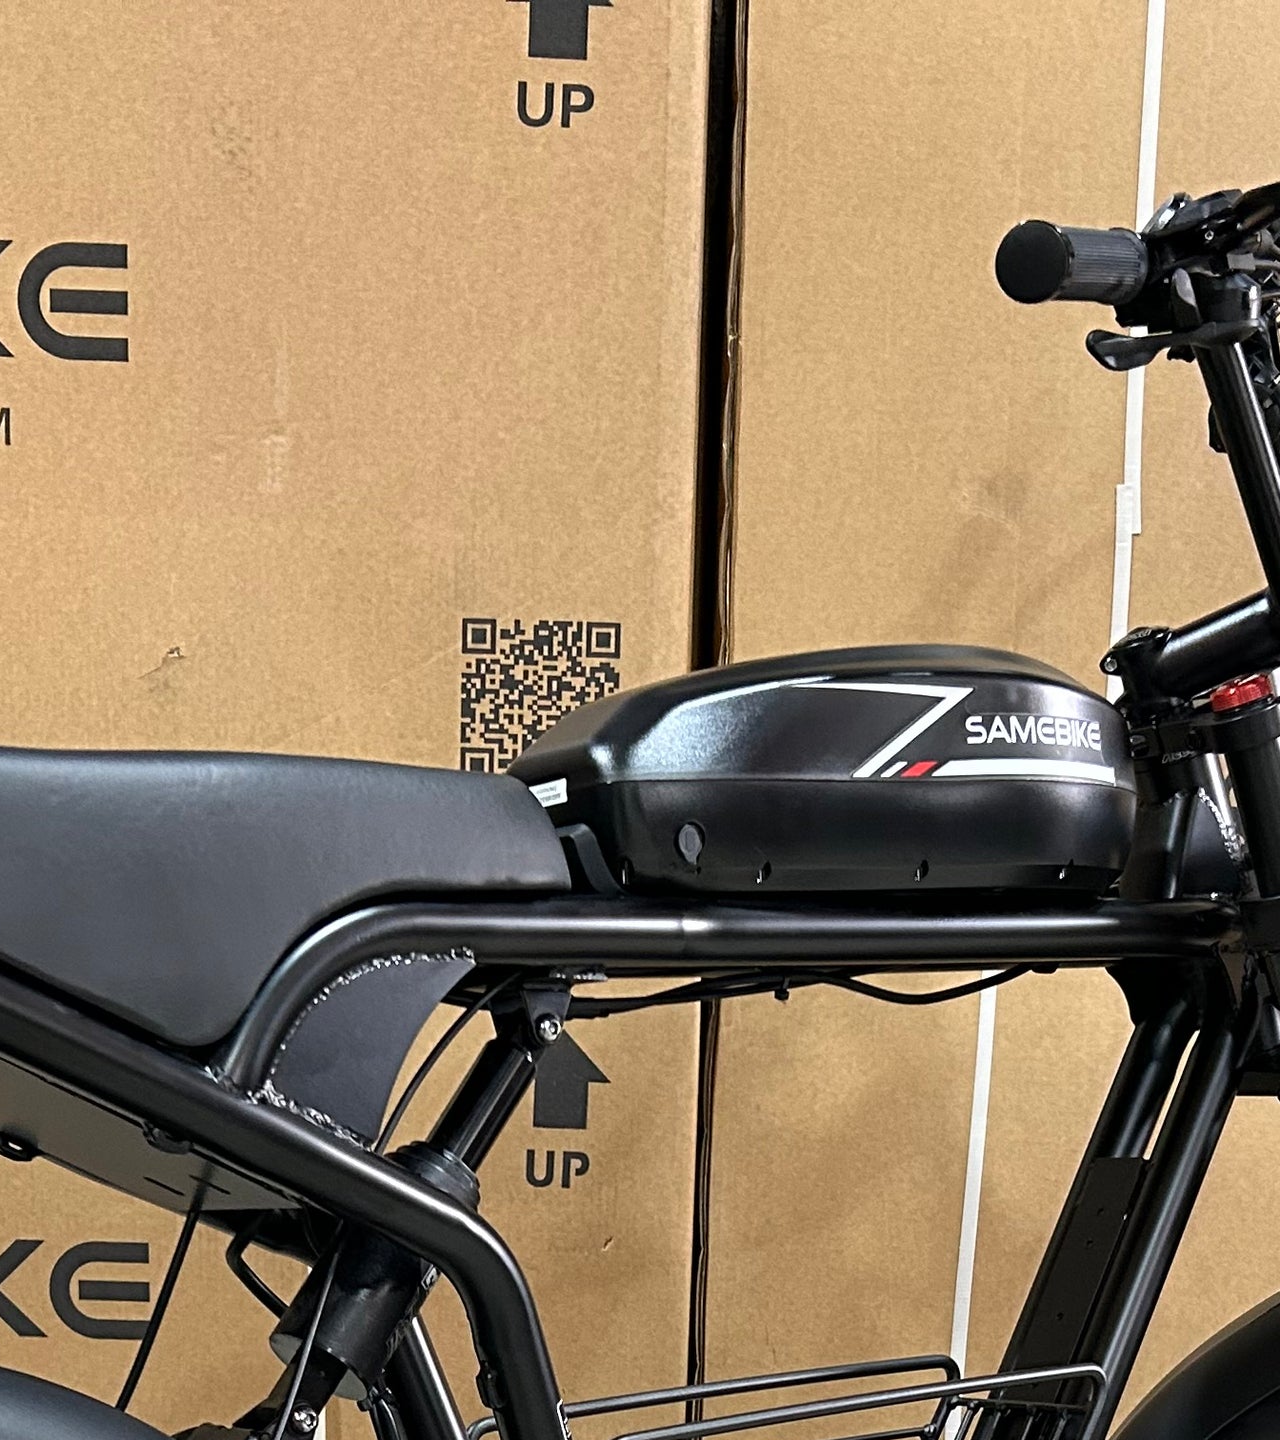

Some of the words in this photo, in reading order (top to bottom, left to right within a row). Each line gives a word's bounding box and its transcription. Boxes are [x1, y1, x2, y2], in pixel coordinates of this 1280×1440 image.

[516, 80, 596, 129] UP
[964, 714, 1102, 751] SAMEBIKE
[524, 1149, 591, 1189] UP
